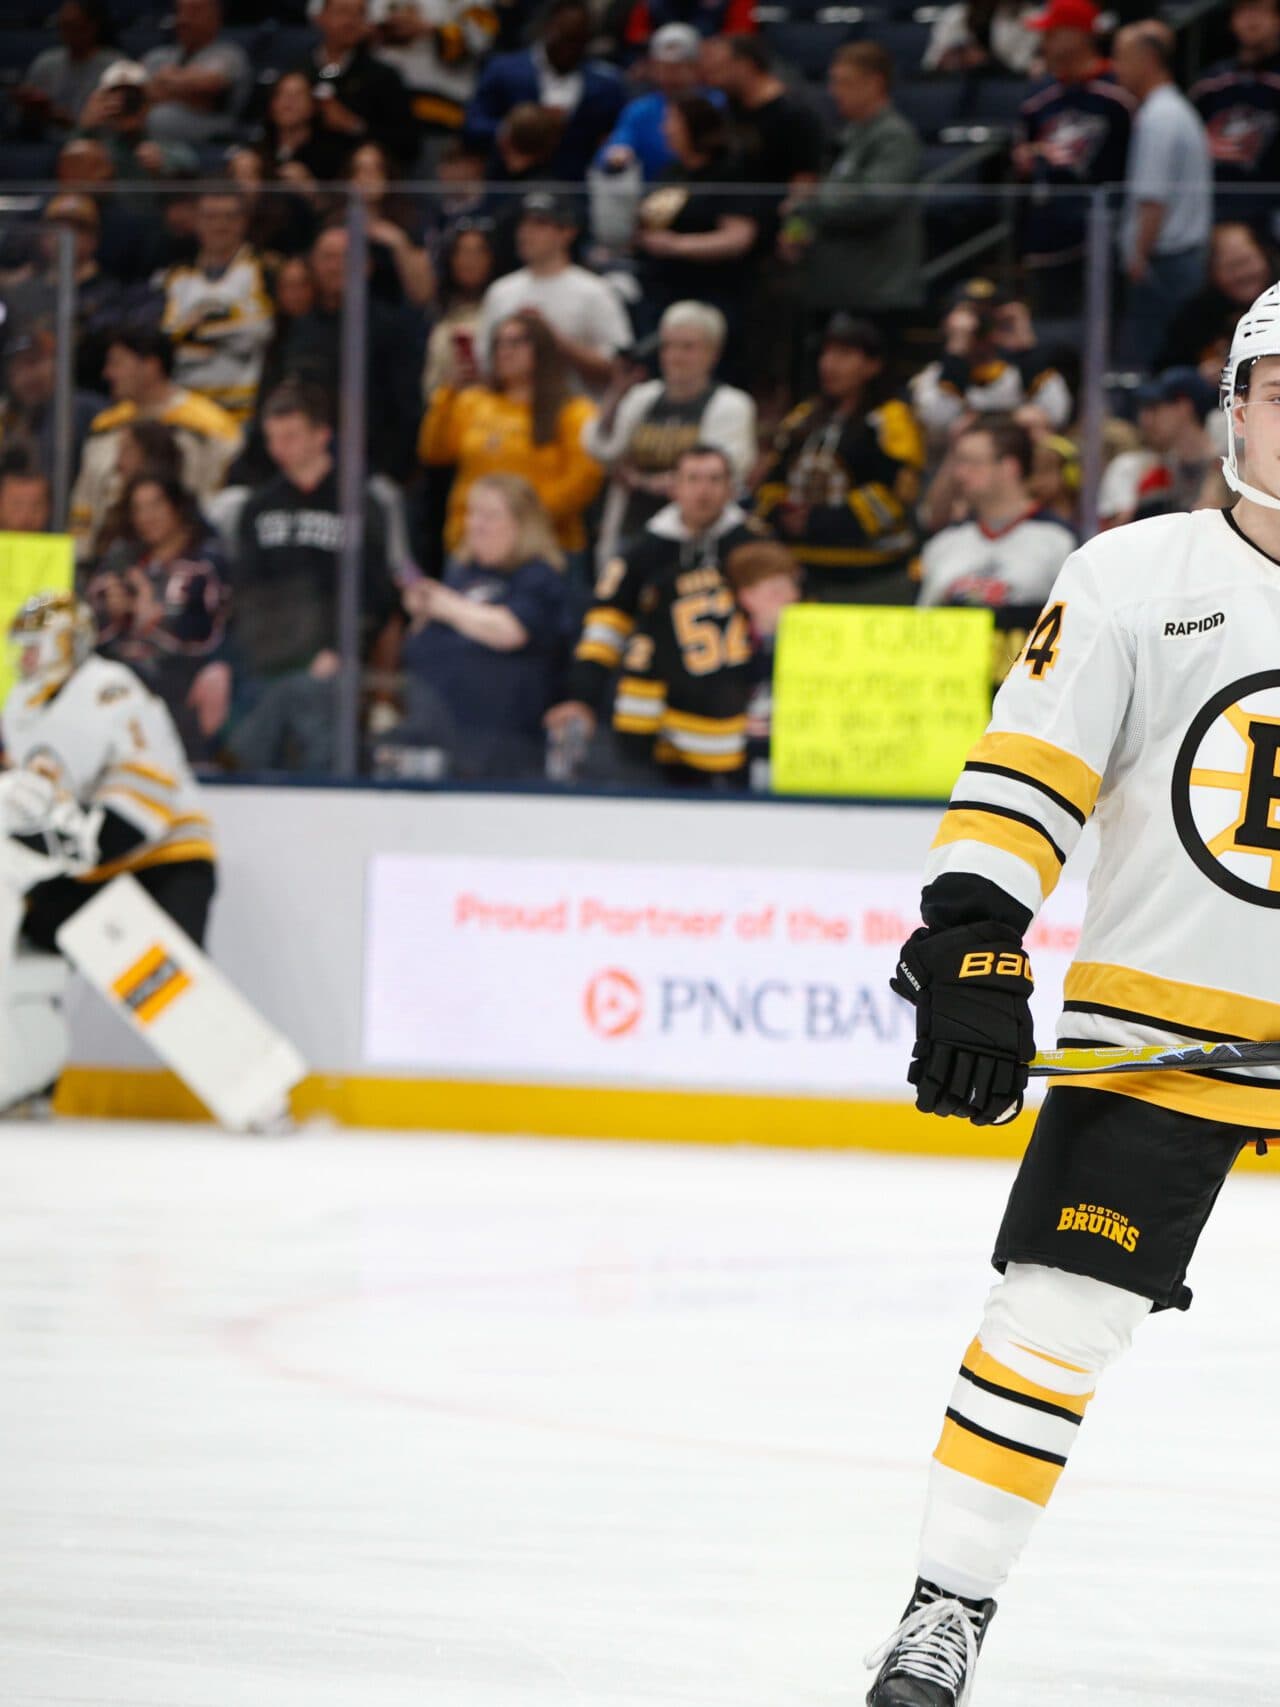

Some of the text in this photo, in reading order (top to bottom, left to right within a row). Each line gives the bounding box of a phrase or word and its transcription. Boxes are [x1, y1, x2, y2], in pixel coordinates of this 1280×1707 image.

[1010, 602, 1067, 681] 4
[454, 892, 568, 934] Proud
[579, 897, 722, 937] Partner
[735, 905, 774, 942] of
[786, 907, 850, 944] the
[659, 974, 918, 1043] PNC BAN
[1056, 1207, 1140, 1253] BRUINS
[1078, 1203, 1129, 1226] BOSTON
